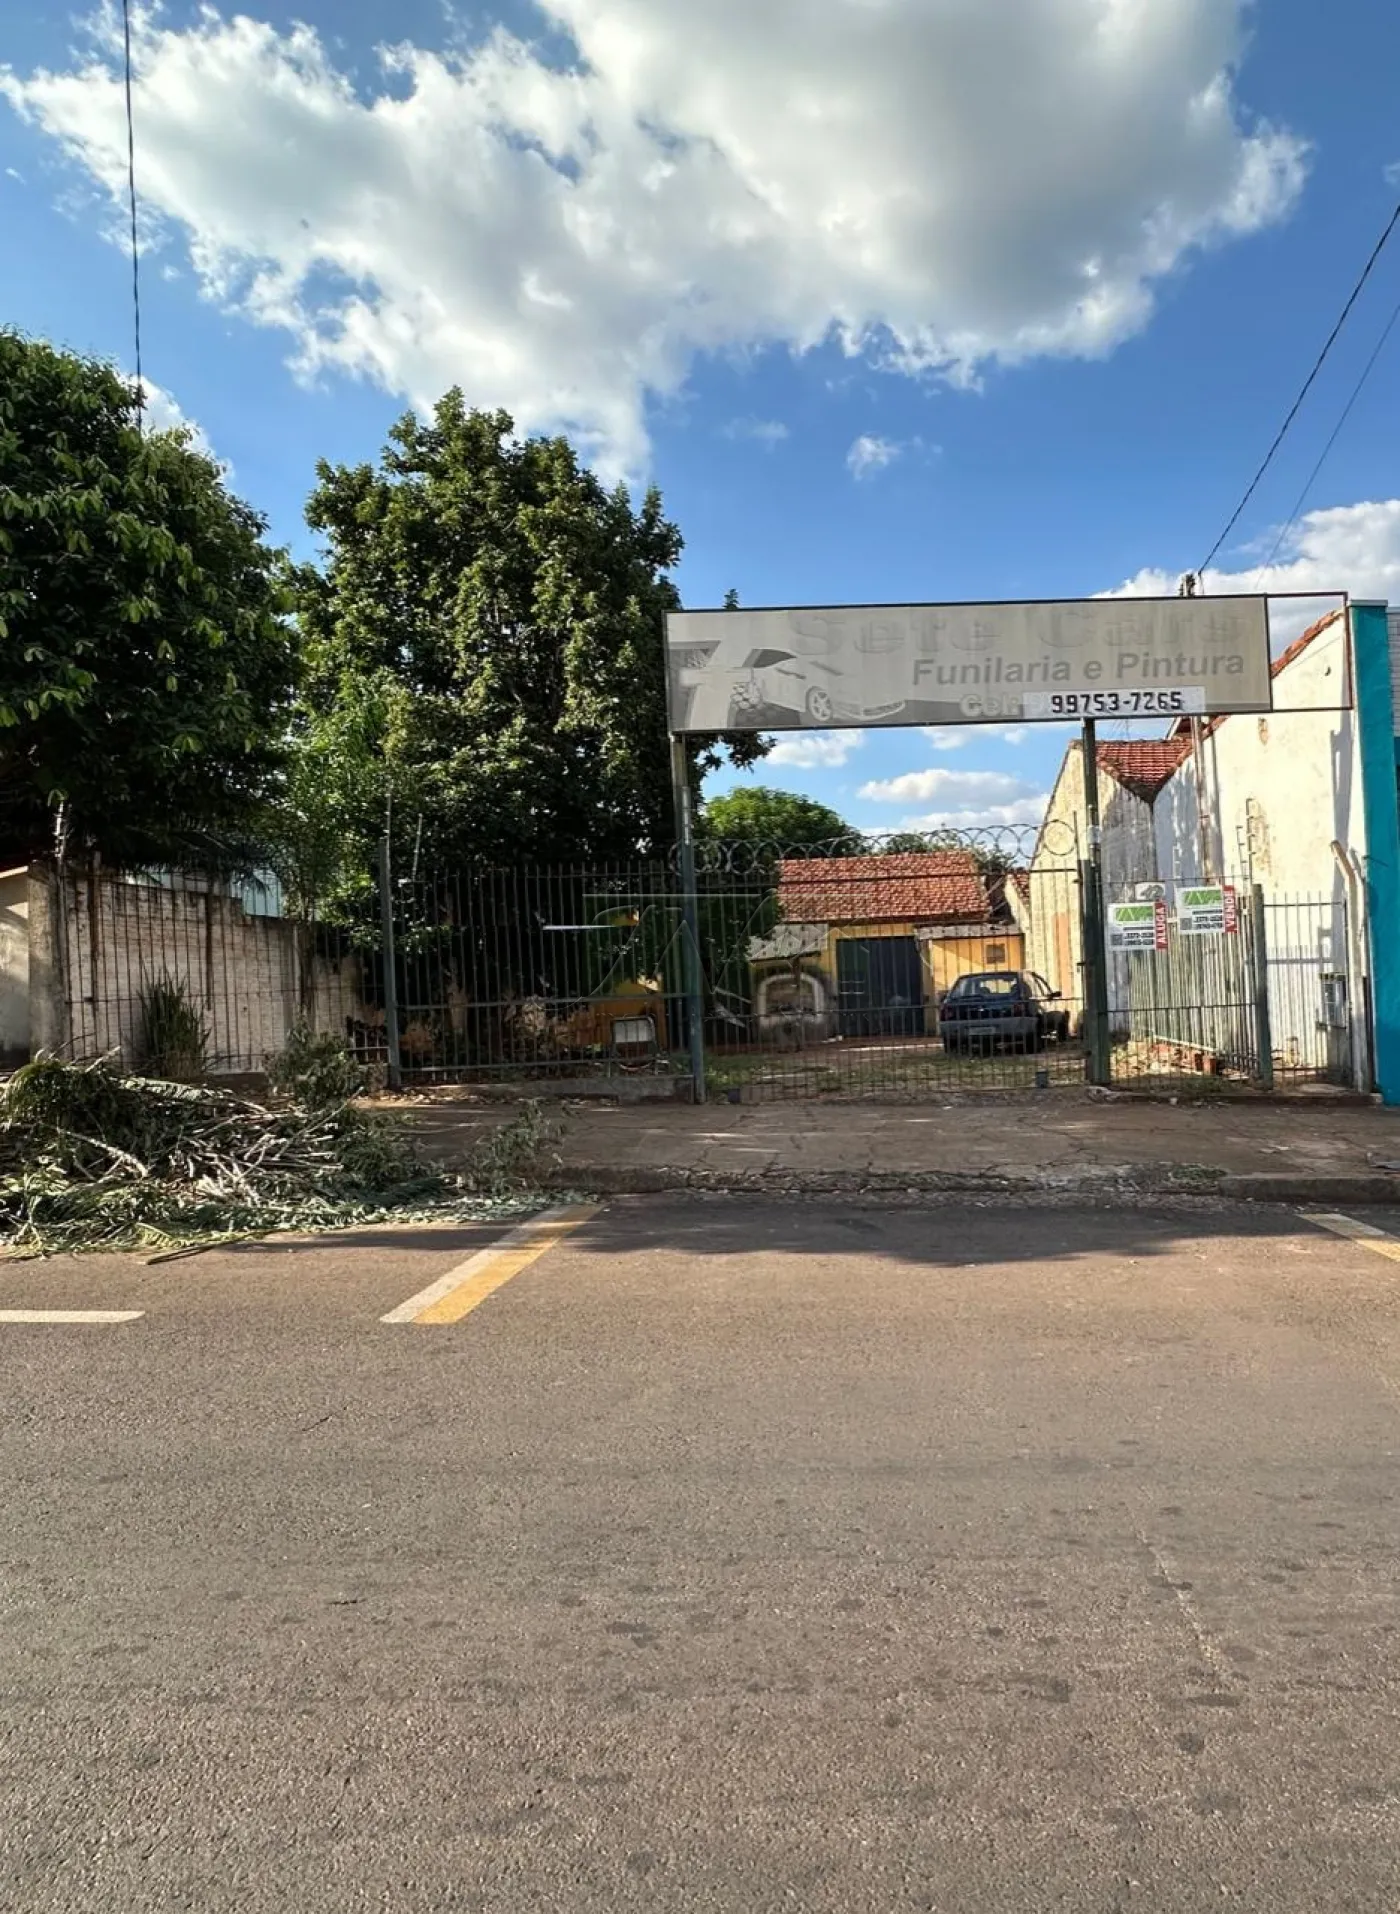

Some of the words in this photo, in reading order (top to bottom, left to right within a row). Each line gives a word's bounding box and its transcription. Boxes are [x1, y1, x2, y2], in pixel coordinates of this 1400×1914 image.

[912, 654, 1071, 686] Funilaria
[1083, 659, 1102, 680] e
[1115, 652, 1244, 679] Pintura
[1051, 691, 1182, 715] 99753-7265
[1156, 907, 1167, 944] ALUGA
[1223, 890, 1235, 927] VENDE
